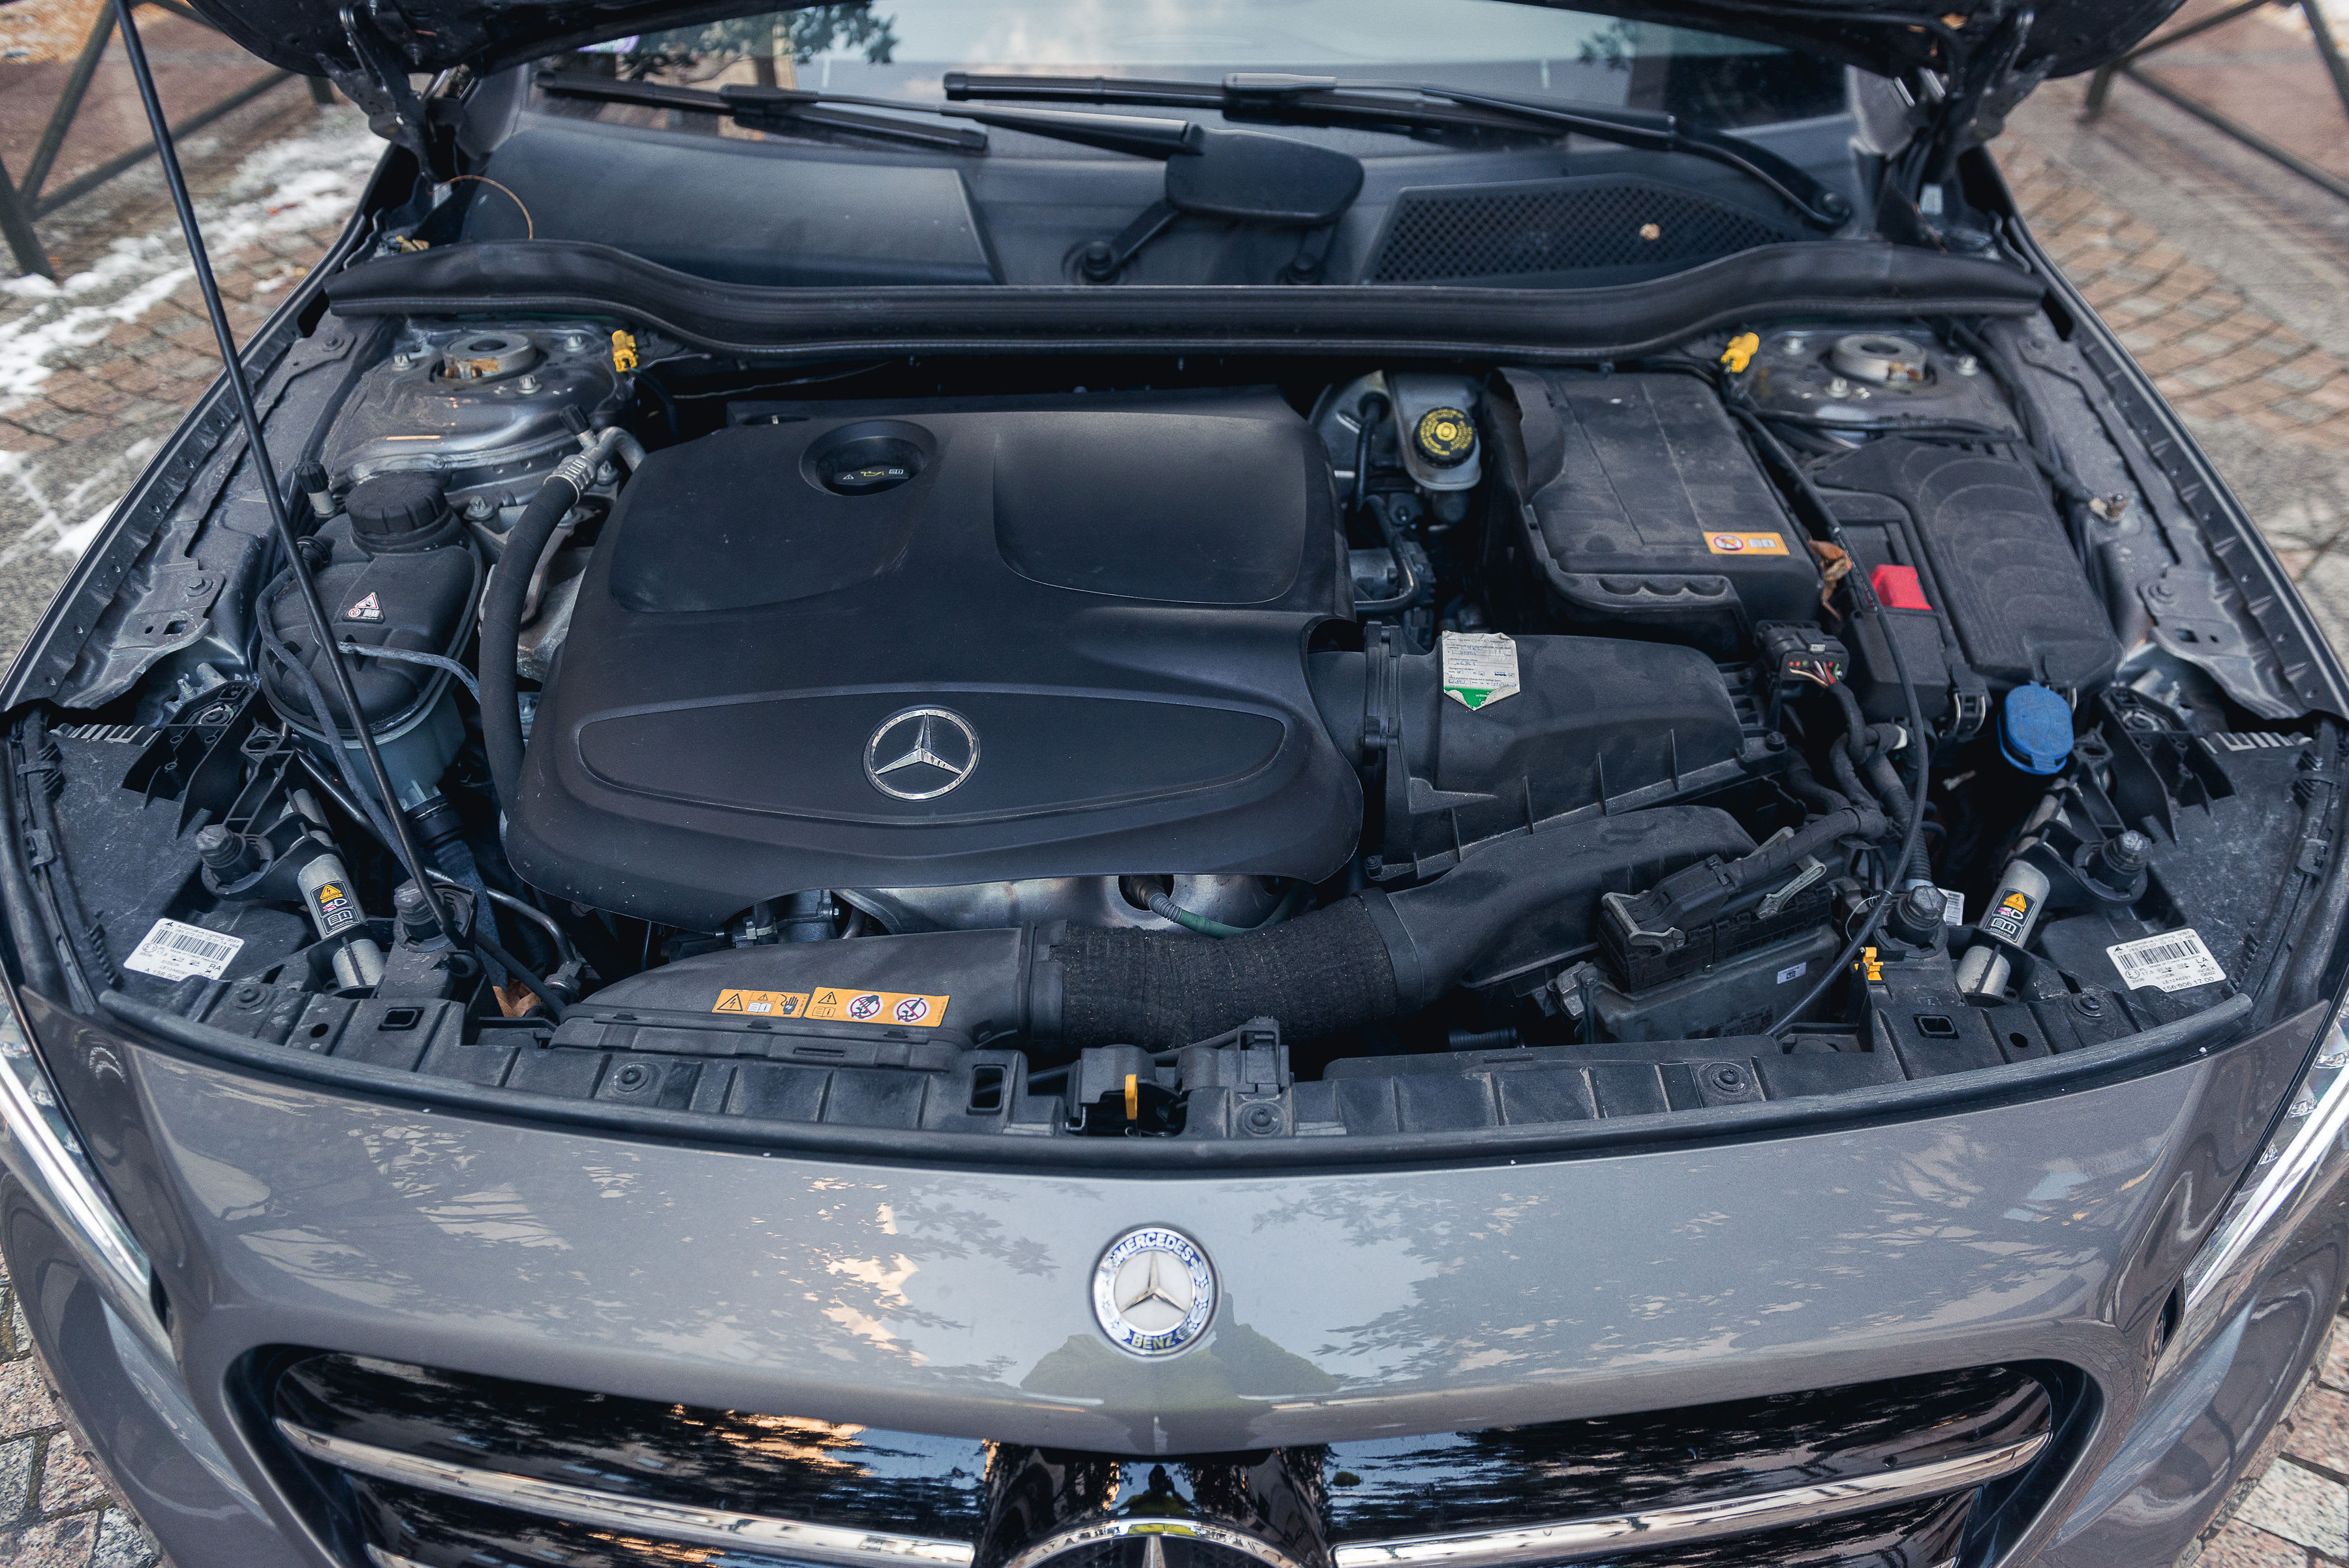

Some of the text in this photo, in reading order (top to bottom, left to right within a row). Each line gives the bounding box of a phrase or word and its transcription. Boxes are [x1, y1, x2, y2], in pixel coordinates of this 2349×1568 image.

[176, 925, 205, 934] Automotive
[204, 932, 225, 940] Lighting
[1116, 1232, 1194, 1263] MERCEDES
[1131, 1332, 1176, 1349] BENZ
